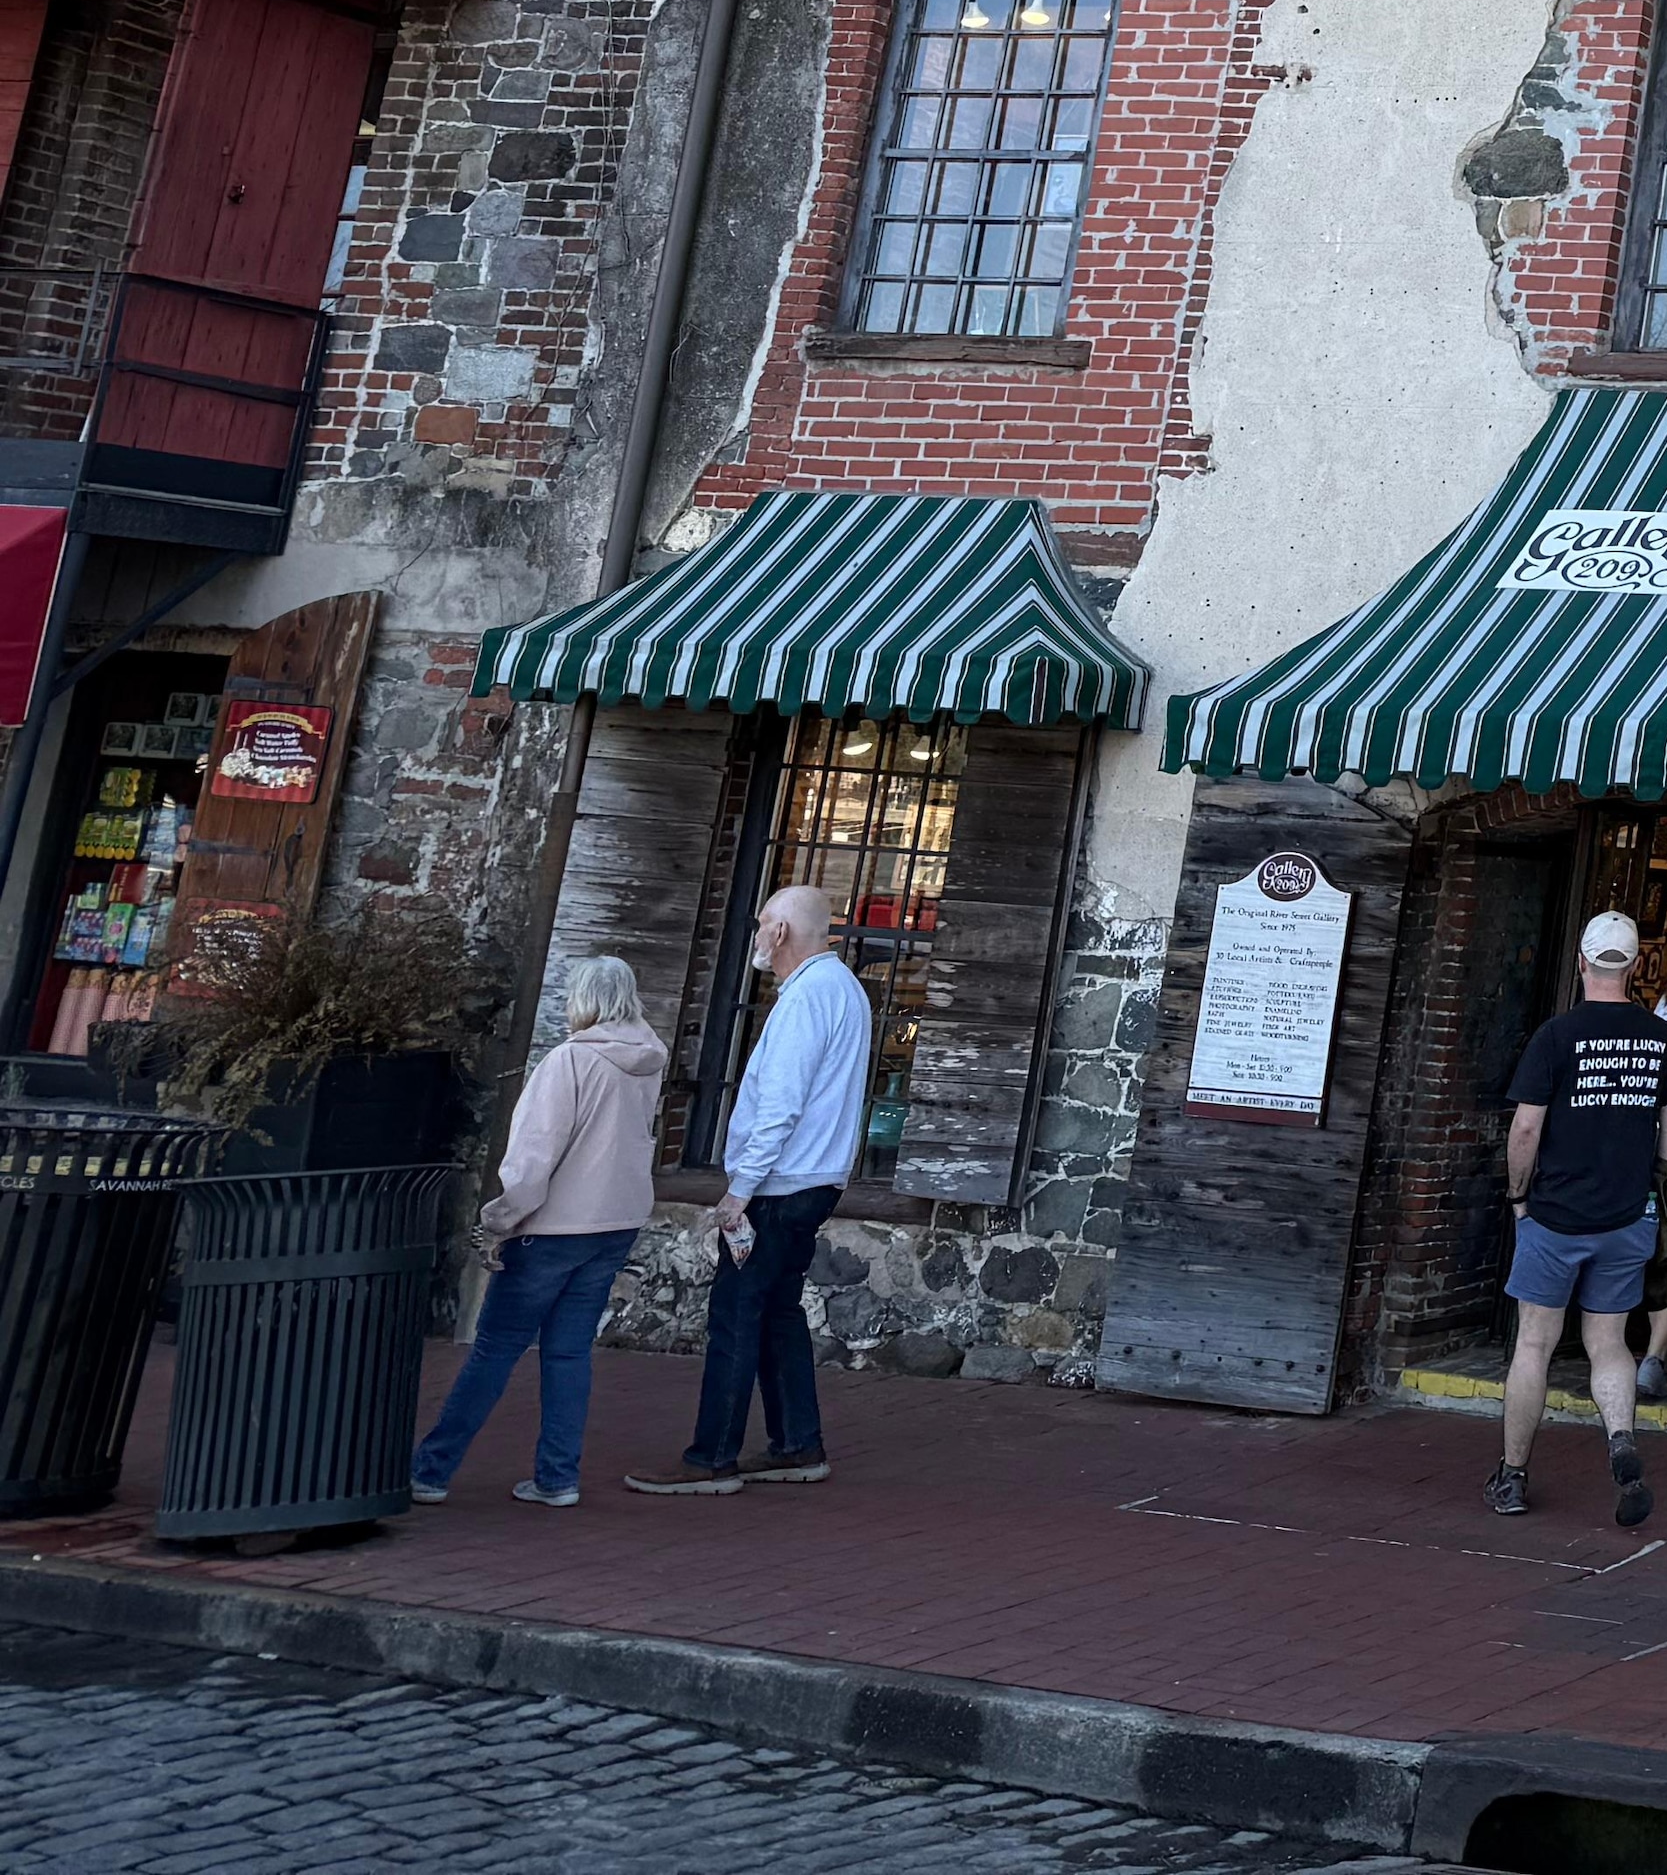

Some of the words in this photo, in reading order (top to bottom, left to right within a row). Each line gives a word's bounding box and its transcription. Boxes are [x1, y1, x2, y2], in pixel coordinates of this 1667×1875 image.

[1574, 557, 1646, 581] 209
[1262, 860, 1312, 894] Gallery
[1575, 1041, 1587, 1054] IF
[1589, 1039, 1631, 1053] YOU'RE
[1633, 1039, 1667, 1054] LUCKY
[1579, 1057, 1629, 1071] ENOUGH
[1631, 1057, 1647, 1071] TO
[1649, 1058, 1662, 1072] BE
[1620, 1075, 1659, 1090] YOU'RE
[1570, 1094, 1608, 1108] LUCKY
[88, 1178, 161, 1192] SAVANNAH
